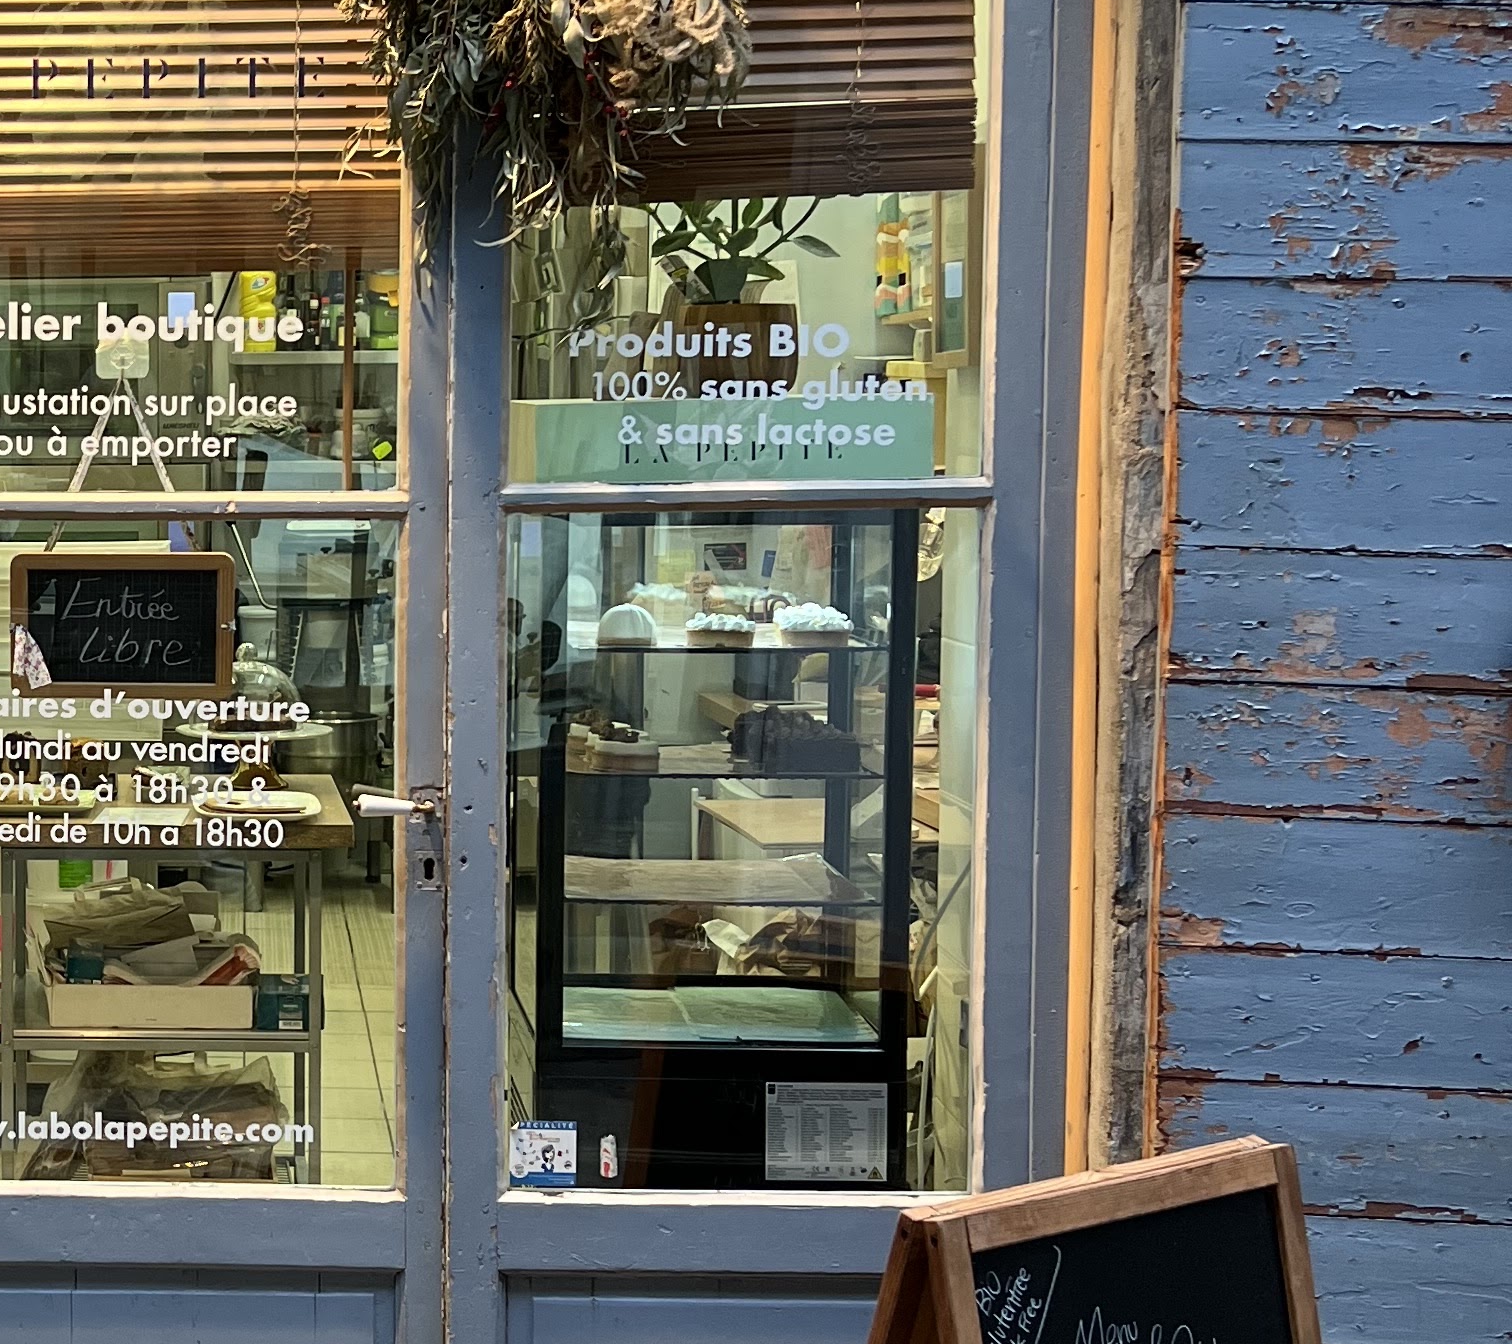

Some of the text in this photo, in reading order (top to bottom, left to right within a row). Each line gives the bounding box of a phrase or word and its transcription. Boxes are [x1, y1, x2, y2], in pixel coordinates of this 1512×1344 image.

[31, 57, 325, 100] PEPITE
[96, 301, 305, 353] boutique
[568, 321, 850, 358] Produits BIO
[143, 393, 194, 419] sur
[206, 383, 298, 425] place
[592, 368, 928, 410] 100% sans gluten
[47, 425, 69, 457] à
[80, 429, 238, 466] emporter
[617, 413, 896, 447] & sans lactose
[60, 576, 181, 621] Entrée
[89, 689, 311, 724] d'ouverture
[81, 739, 122, 763] au
[131, 734, 270, 765] vendredi
[94, 775, 115, 804] à
[132, 774, 233, 805] 18h30
[249, 777, 271, 806] &
[50, 814, 88, 845] de
[100, 816, 151, 847] 10h
[192, 818, 285, 849] 18h30
